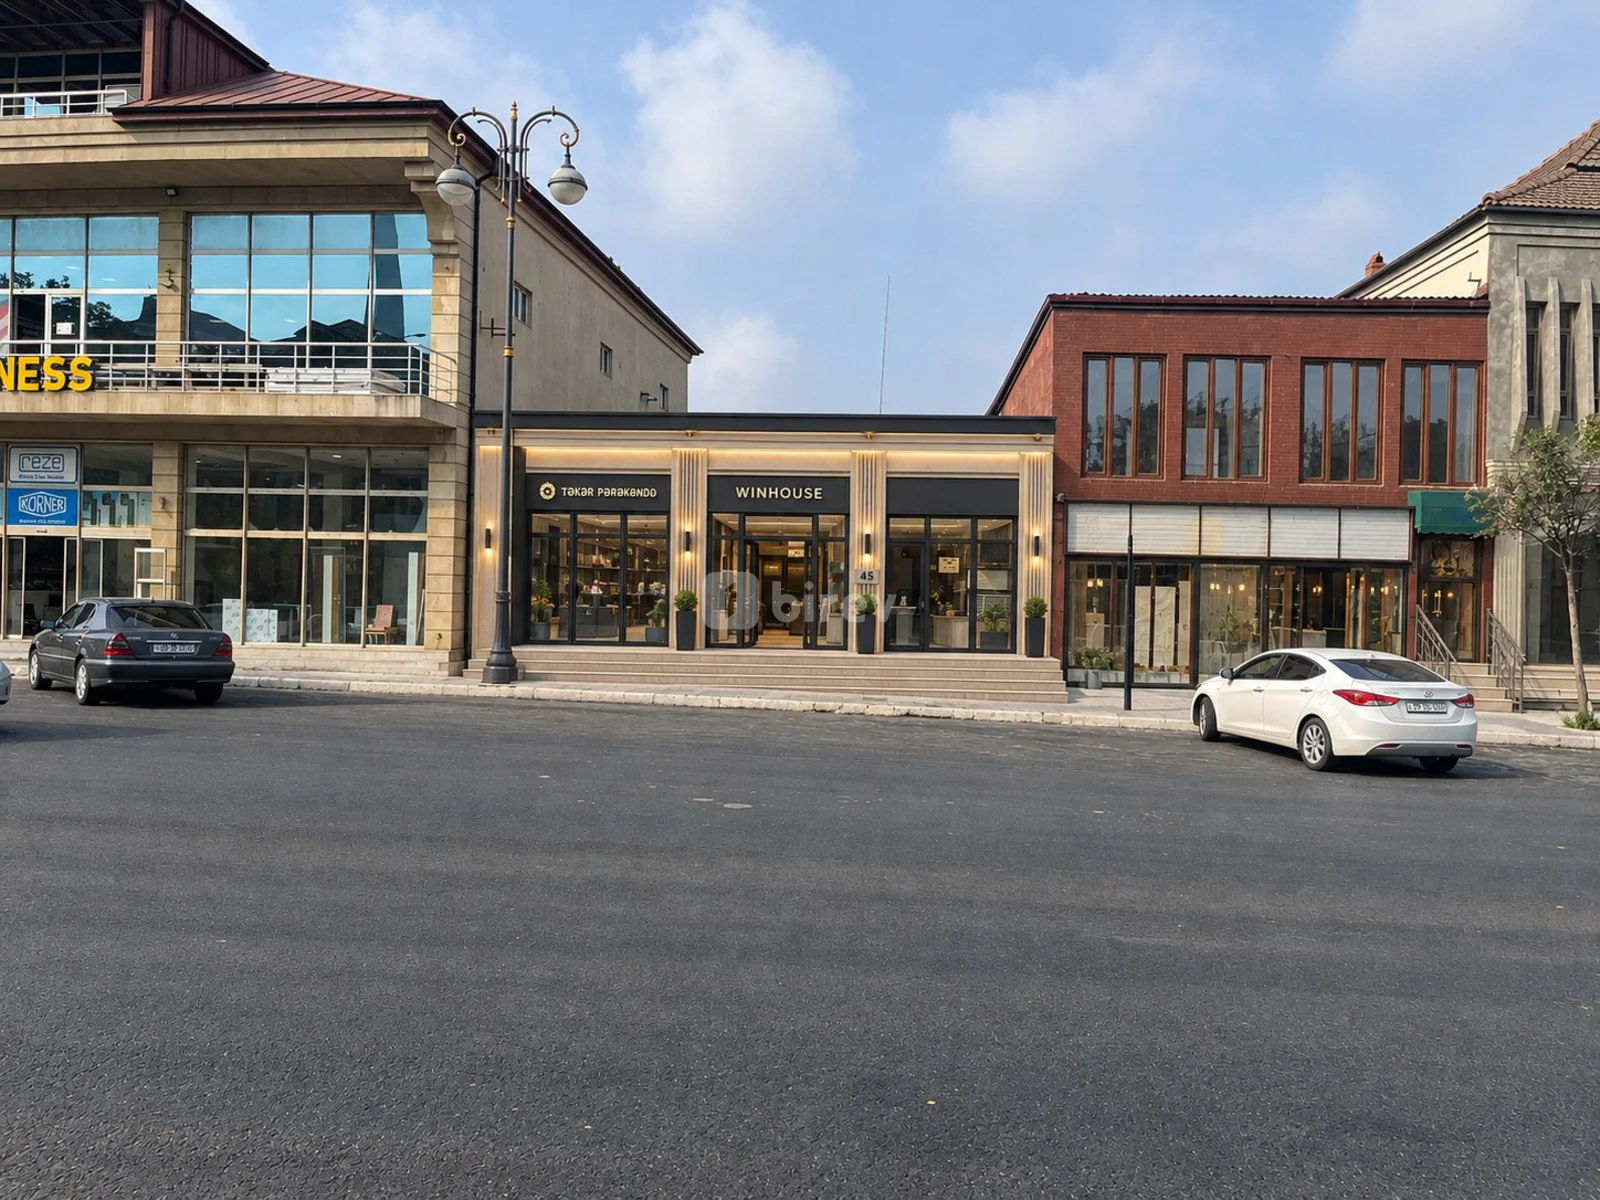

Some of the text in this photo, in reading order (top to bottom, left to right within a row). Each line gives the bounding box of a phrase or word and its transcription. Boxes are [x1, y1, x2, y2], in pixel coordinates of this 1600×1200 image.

[0, 355, 94, 392] NESS
[21, 455, 62, 470] reze
[735, 486, 823, 499] WINHOUSE
